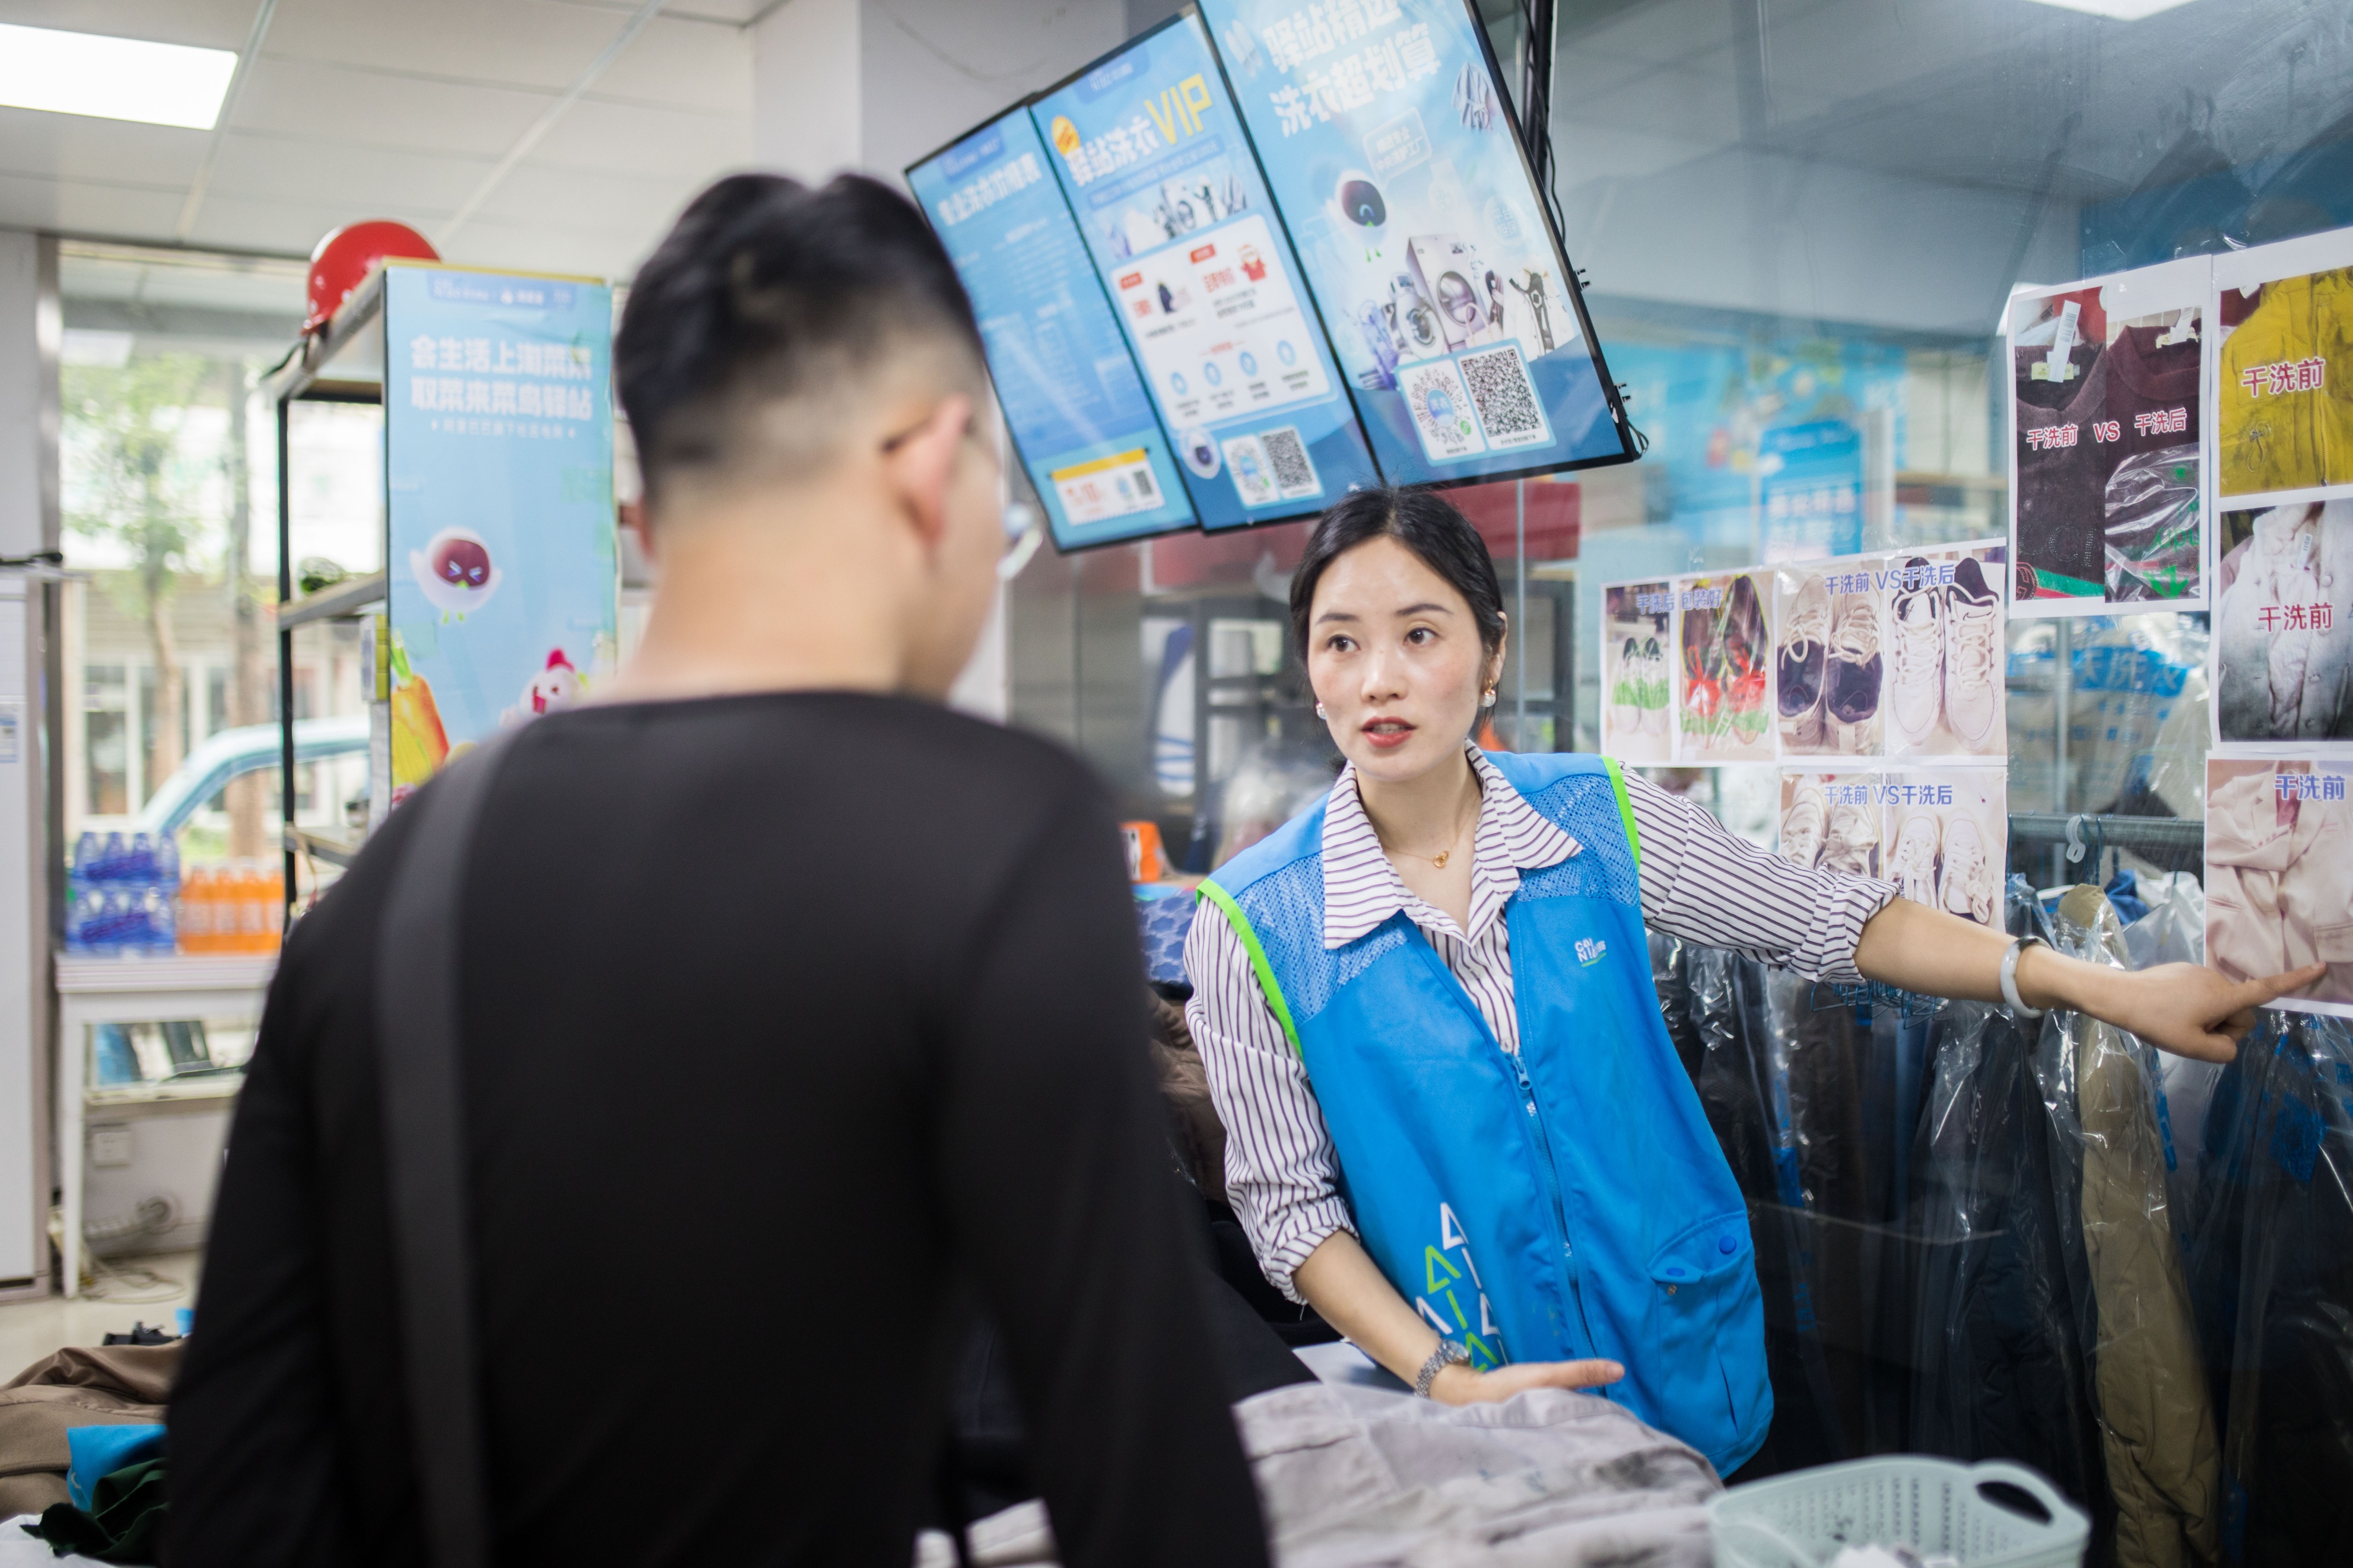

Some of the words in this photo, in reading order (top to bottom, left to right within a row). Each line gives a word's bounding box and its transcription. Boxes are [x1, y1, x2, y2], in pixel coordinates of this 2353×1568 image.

[1269, 22, 1441, 138] 洗衣超划算
[1144, 73, 1213, 145] VIP
[2242, 357, 2326, 397] 干洗前
[2027, 424, 2078, 451] 干洗前
[2094, 421, 2120, 443] VS
[2135, 408, 2187, 437] 干洗后
[1825, 572, 1870, 596] 干洗前
[1875, 570, 1901, 590] VS
[1903, 565, 1954, 587] 干洗后
[1637, 593, 1674, 615] 干洗后
[1681, 587, 1722, 610] 包装好
[2258, 601, 2333, 632] 干洗前
[1825, 785, 1868, 806] 干洗前
[1873, 785, 1899, 805] VS
[1901, 785, 1952, 806] 干洗后
[2274, 774, 2345, 801] 干洗前
